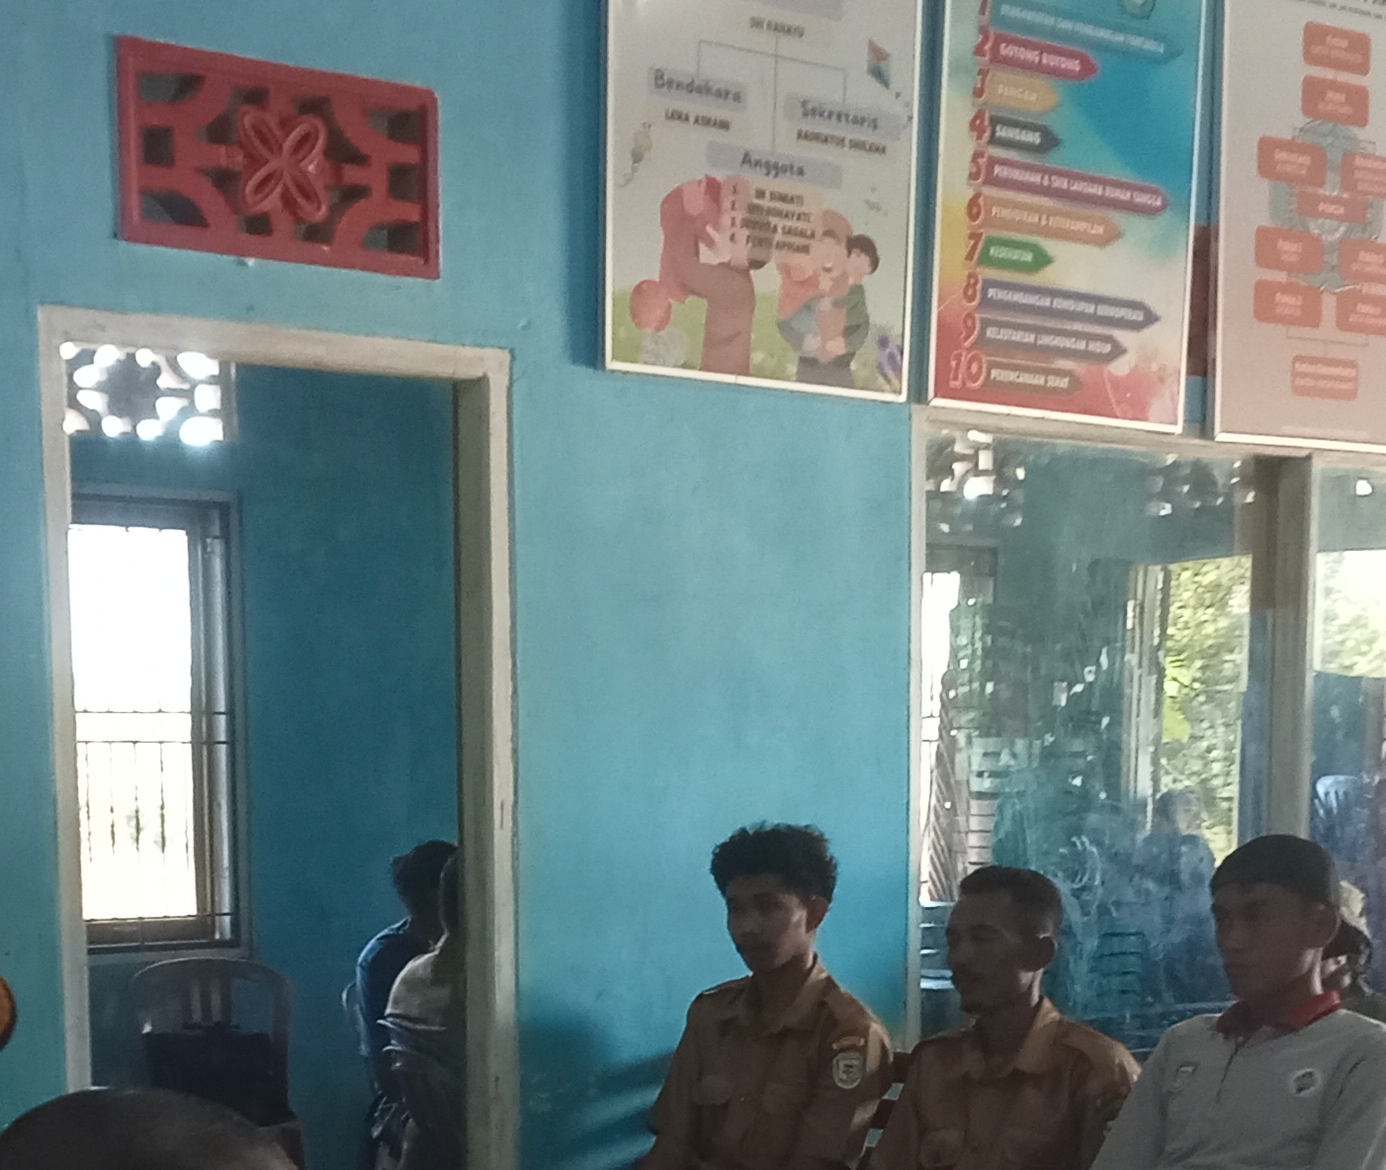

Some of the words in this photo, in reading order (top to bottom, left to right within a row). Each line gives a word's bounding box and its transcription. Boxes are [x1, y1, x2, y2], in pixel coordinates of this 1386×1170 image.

[653, 66, 743, 105] Bendahara
[800, 98, 880, 131] Sekretaris
[740, 149, 806, 178] Anggota
